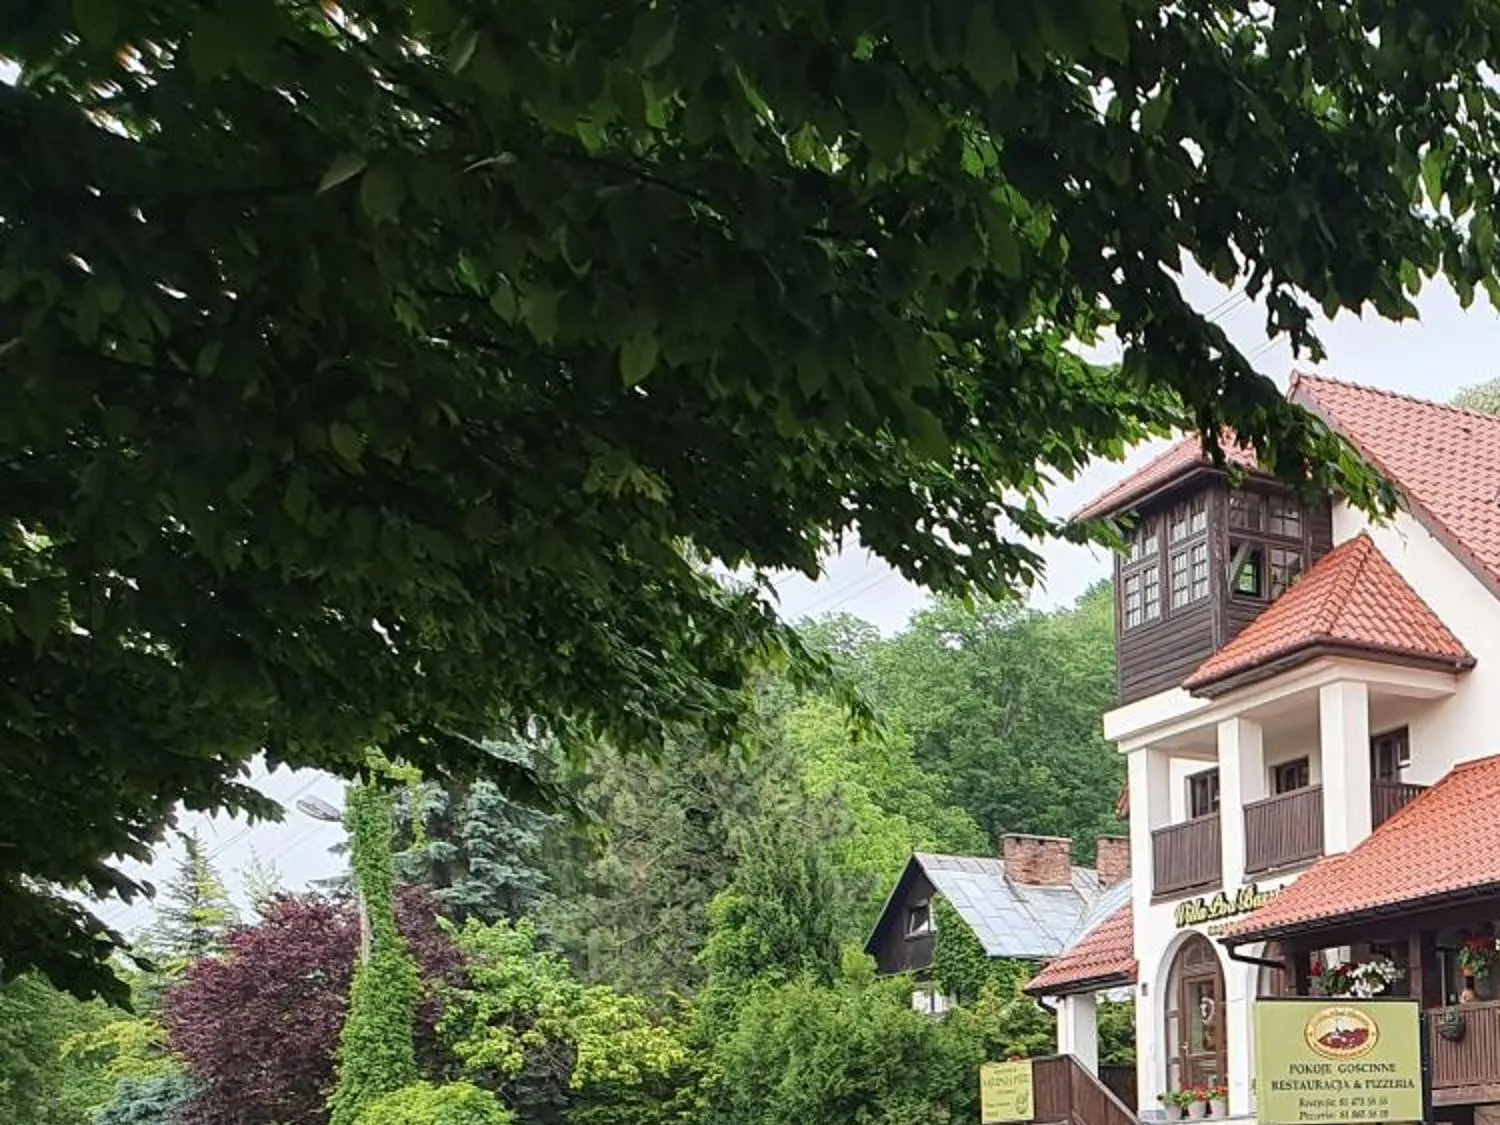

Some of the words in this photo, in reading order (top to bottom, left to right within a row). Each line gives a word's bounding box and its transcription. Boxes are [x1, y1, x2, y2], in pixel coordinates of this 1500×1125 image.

[1289, 1063, 1332, 1076] POKOJE
[1271, 1079, 1350, 1092] RESTAURACJA
[1353, 1079, 1363, 1090] &
[1365, 1078, 1415, 1090] PIZZERIA
